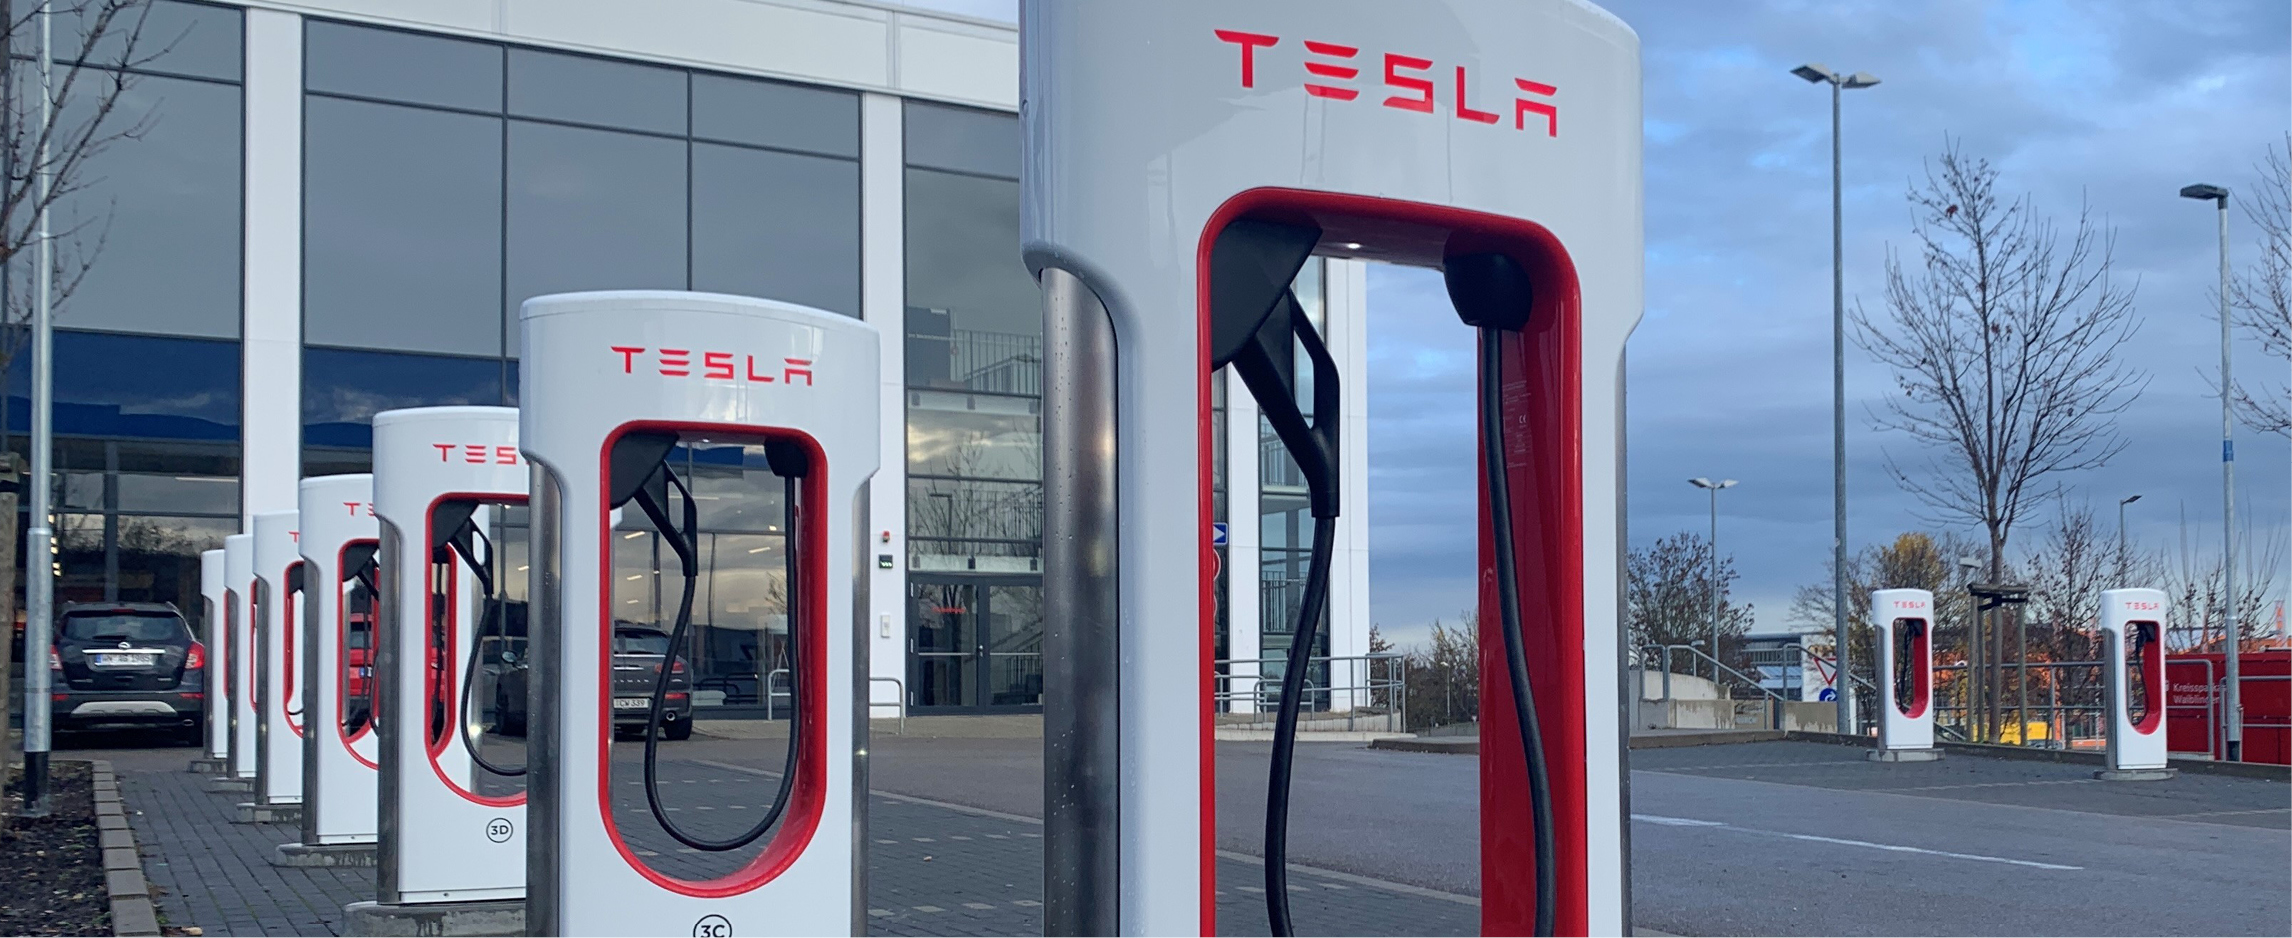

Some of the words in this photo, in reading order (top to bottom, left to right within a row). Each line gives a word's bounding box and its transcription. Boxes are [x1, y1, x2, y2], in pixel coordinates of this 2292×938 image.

[1214, 29, 1558, 138] TESLA
[610, 346, 813, 387] TESLA
[432, 443, 529, 466] TES
[1893, 600, 1926, 609] TESLA
[2125, 602, 2159, 610] TESLA
[491, 825, 509, 835] 3D
[700, 924, 725, 938] 3C
